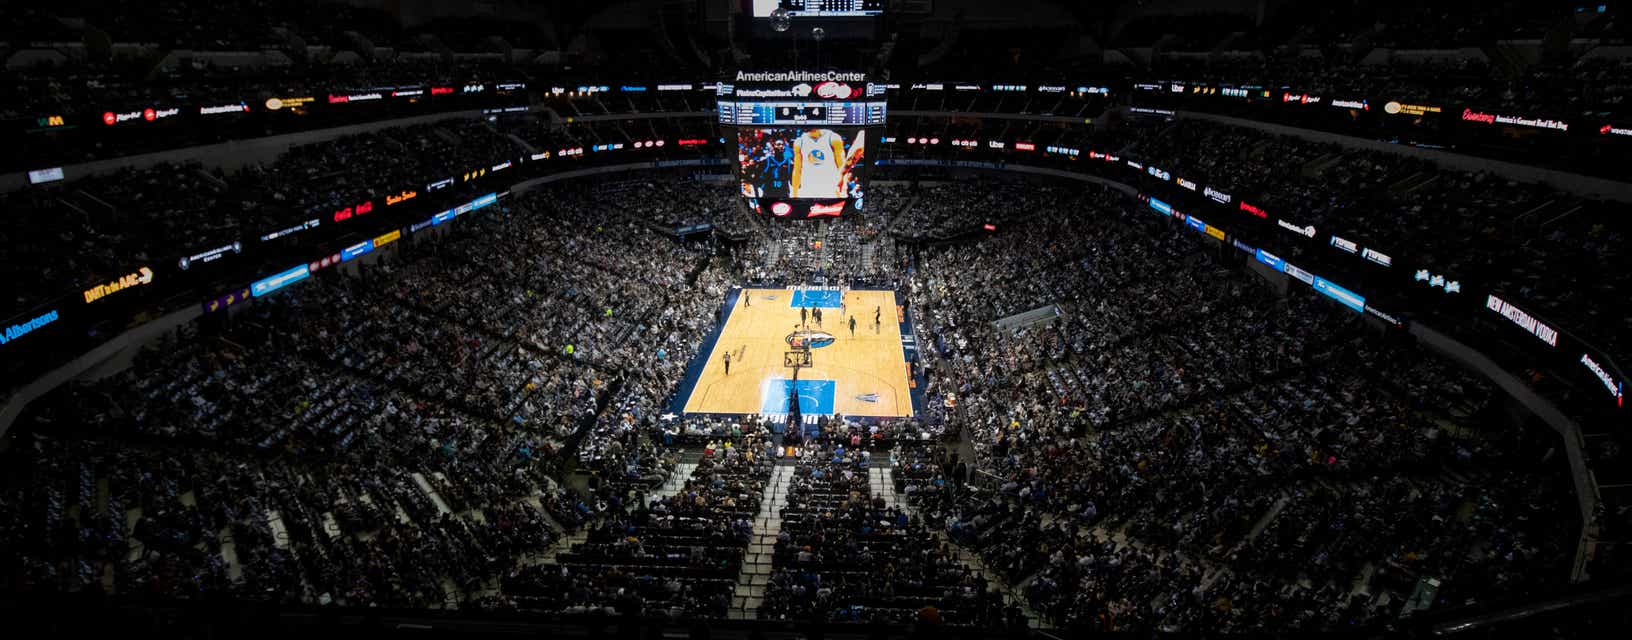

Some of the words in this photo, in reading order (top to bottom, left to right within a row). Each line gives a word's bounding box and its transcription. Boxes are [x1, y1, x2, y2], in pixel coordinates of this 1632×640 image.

[736, 71, 865, 82] AmericanAirlinesCenter
[84, 284, 105, 304] DART
[119, 273, 139, 290] AAC
[5, 309, 59, 342] Albertsons
[1486, 294, 1503, 313] NEW
[1500, 301, 1537, 334] AMSTERDAM
[1535, 321, 1558, 347] VODKA
